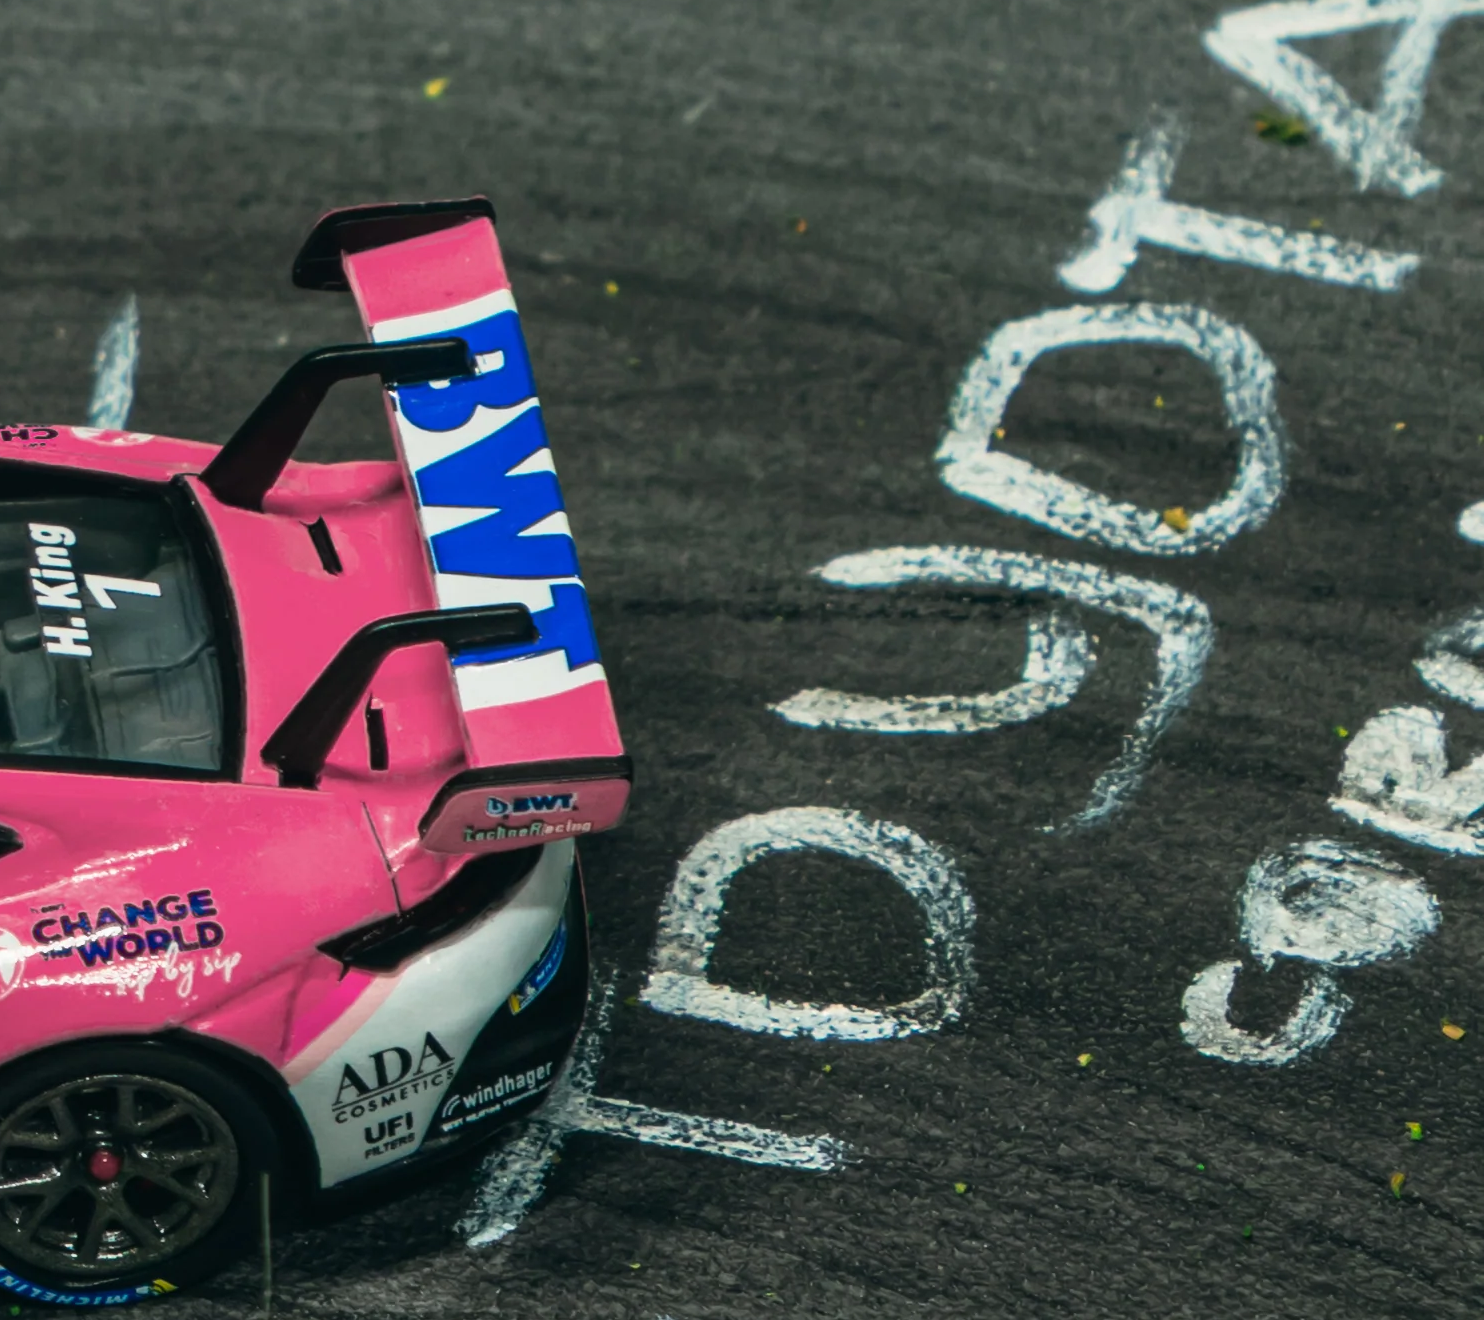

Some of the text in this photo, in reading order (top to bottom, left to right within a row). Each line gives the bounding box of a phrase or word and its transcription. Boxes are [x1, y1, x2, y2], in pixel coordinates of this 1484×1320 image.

[382, 311, 602, 674] BWT
[27, 522, 93, 658] H. King
[512, 792, 578, 813] BWT
[31, 889, 218, 945] CHANGE
[77, 921, 224, 968] WORLD
[330, 1030, 456, 1107] ADA
[461, 1061, 555, 1110] windhager
[334, 1068, 455, 1124] COSMETICS
[363, 1111, 415, 1145] UFI
[363, 1131, 416, 1160] FILTERS
